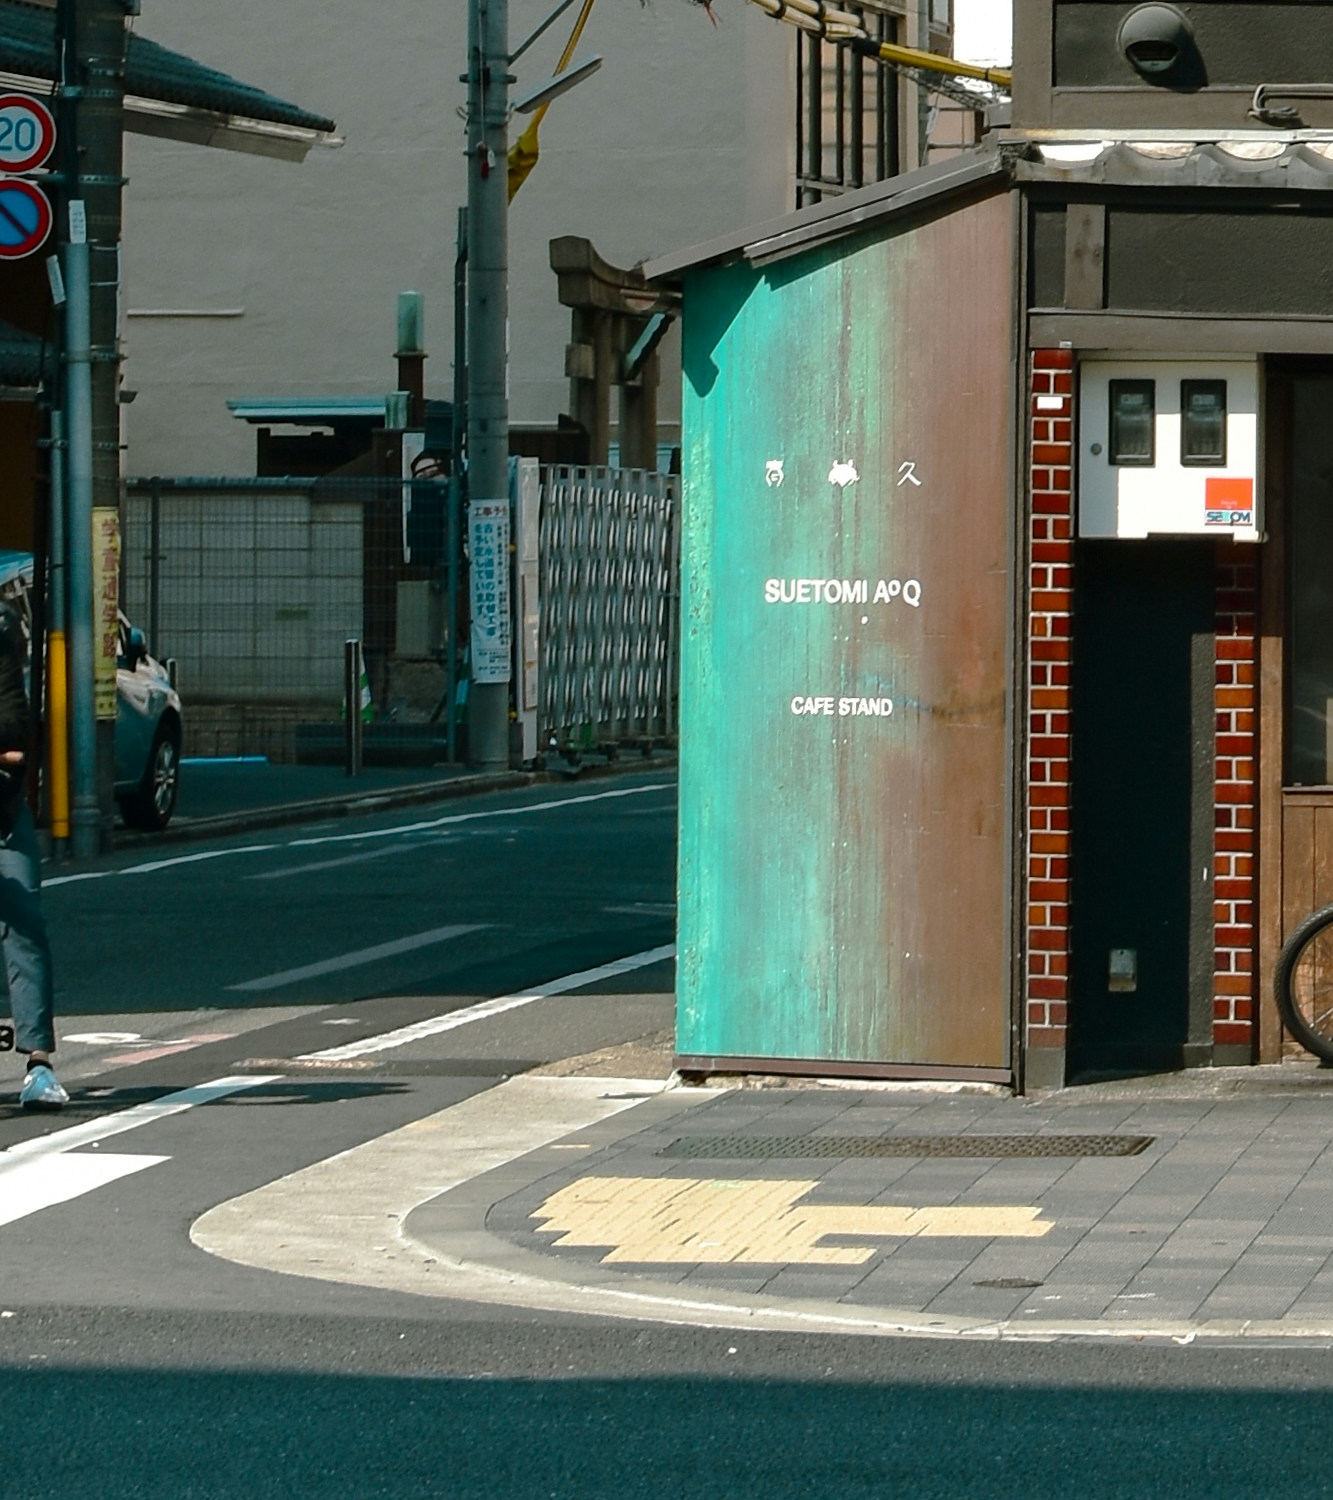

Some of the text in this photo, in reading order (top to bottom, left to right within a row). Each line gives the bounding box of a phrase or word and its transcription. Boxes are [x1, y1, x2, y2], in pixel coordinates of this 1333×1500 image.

[0, 117, 36, 152] 20
[765, 579, 868, 604] SUETOMI
[790, 697, 893, 717] CAFE STAND
